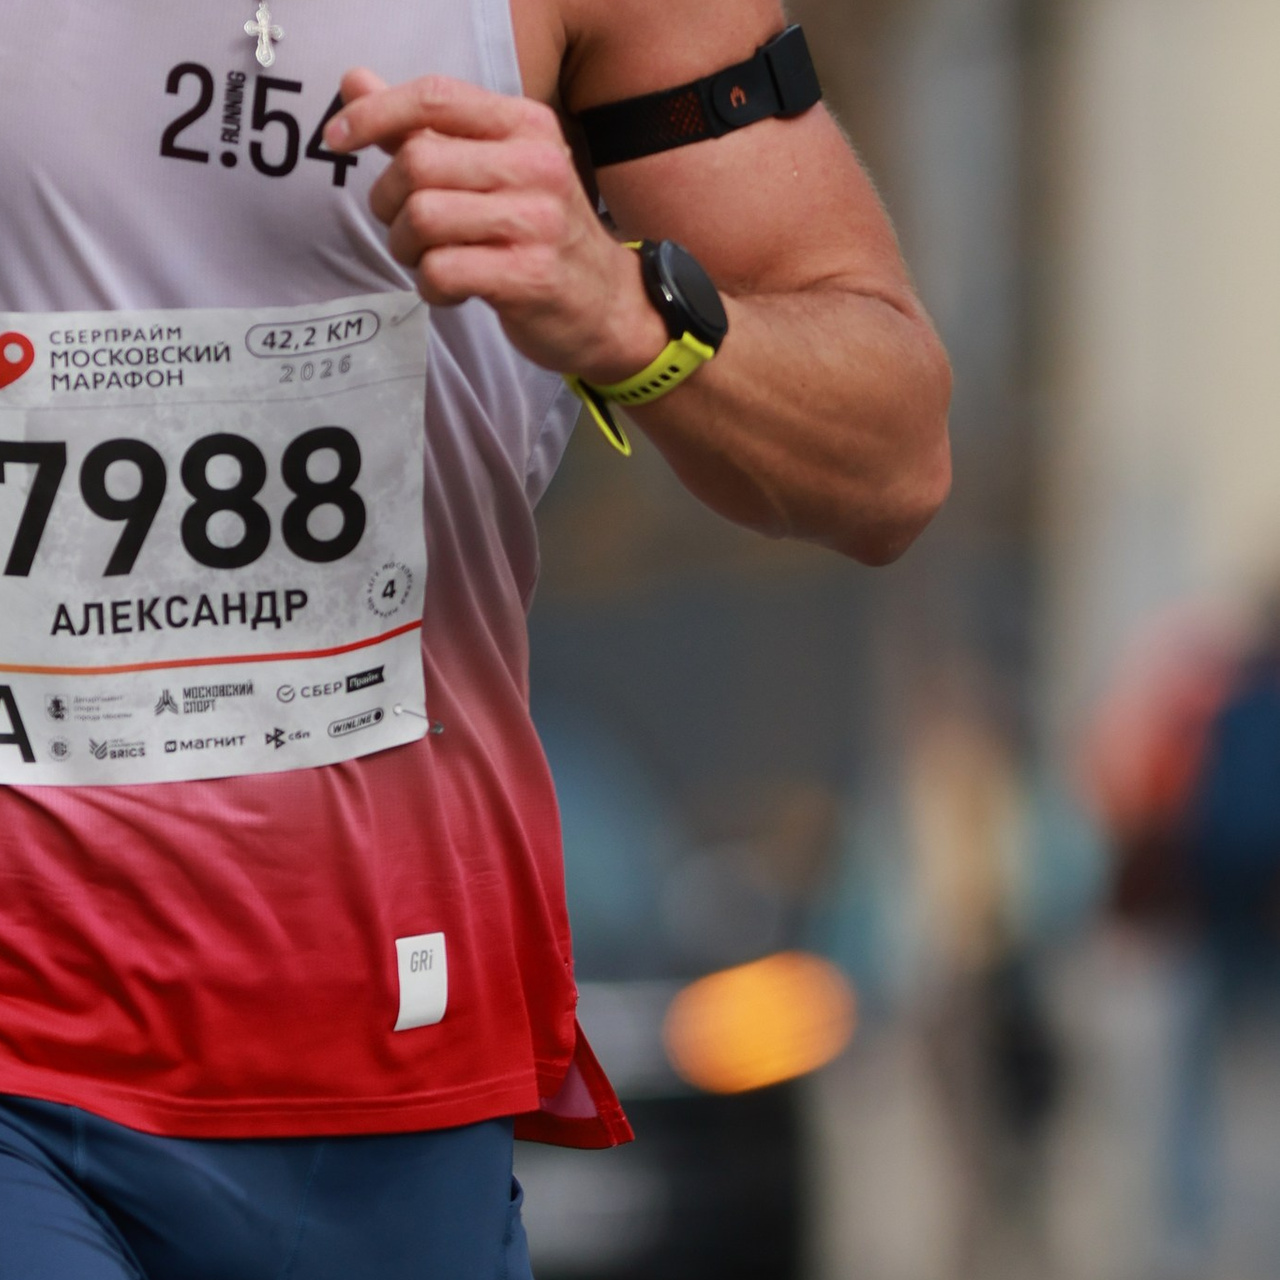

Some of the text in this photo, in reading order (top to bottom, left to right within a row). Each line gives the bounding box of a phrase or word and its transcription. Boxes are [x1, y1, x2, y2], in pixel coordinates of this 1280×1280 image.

[221, 71, 246, 144] RUNNING
[49, 324, 182, 345] СБЕРПРАЙМ
[261, 326, 317, 351] 42,2
[50, 341, 231, 368] МОСКОВСКИЙ
[278, 353, 352, 384] 2026
[51, 368, 184, 391] МАРАФОН
[382, 578, 397, 599] 4
[50, 589, 309, 636] АЛЕКСАНДР
[182, 680, 254, 700] МОСКОВСКИЙ
[300, 681, 343, 698] СБЕР
[183, 699, 217, 714] СПОРТ
[332, 714, 373, 734] WINLINE
[109, 747, 146, 759] BRICS
